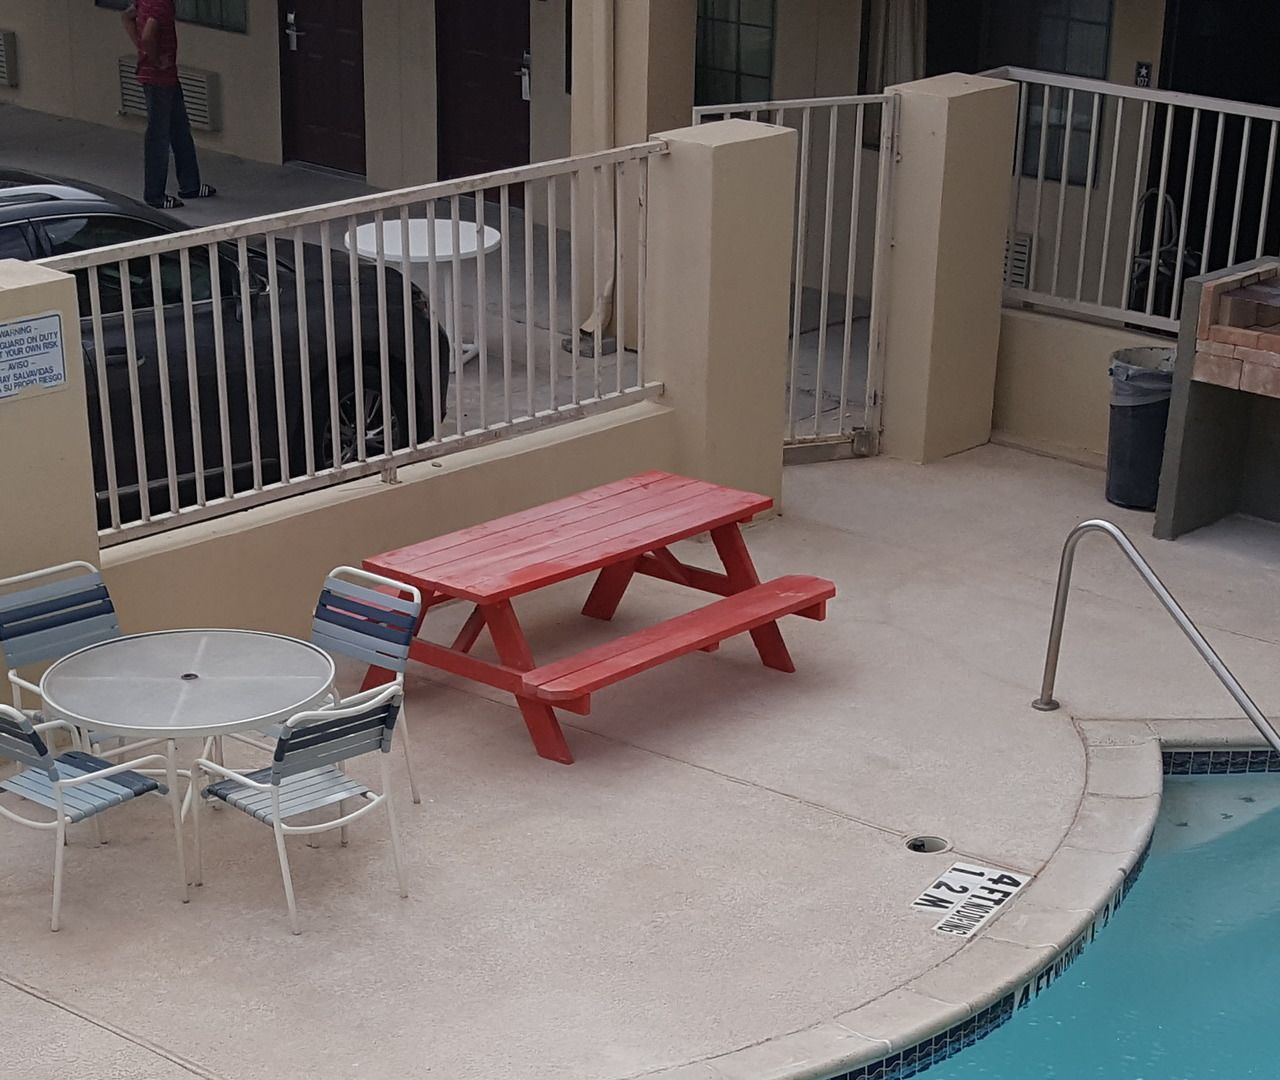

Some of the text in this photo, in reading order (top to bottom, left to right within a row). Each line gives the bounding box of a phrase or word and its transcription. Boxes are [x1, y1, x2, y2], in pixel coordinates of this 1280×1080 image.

[26, 335, 38, 346] ON
[39, 331, 58, 343] DUTY
[5, 347, 24, 359] YOUR
[25, 344, 41, 354] OWN
[42, 341, 59, 351] RISK
[7, 359, 29, 371] AVISO
[13, 366, 54, 381] SALVAVIDAS
[4, 382, 13, 393] SU
